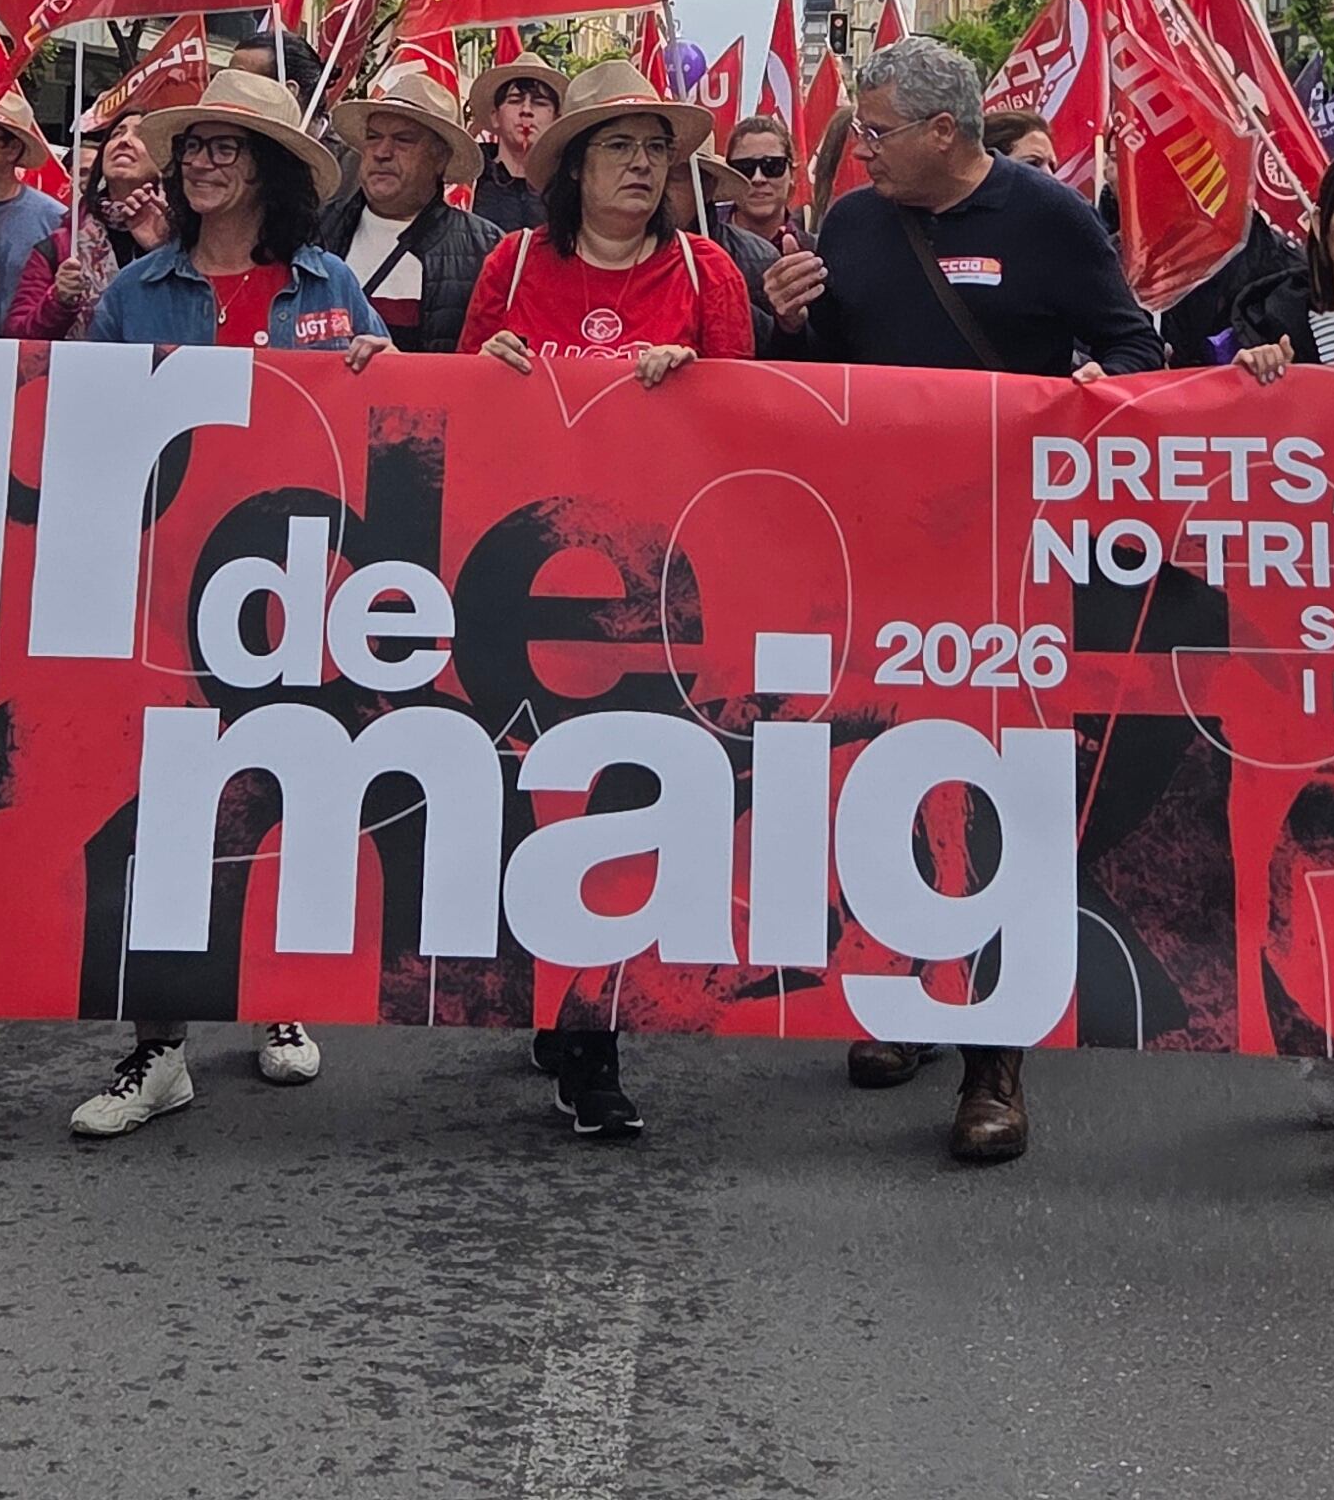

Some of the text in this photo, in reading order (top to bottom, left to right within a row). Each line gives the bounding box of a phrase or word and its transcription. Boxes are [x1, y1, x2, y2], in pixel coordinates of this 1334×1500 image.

[295, 318, 328, 338] UGT
[1030, 519, 1162, 586] NO
[195, 515, 457, 692] de
[873, 619, 1068, 690] 2026
[1301, 668, 1315, 715] I
[127, 630, 1078, 1048] maig
